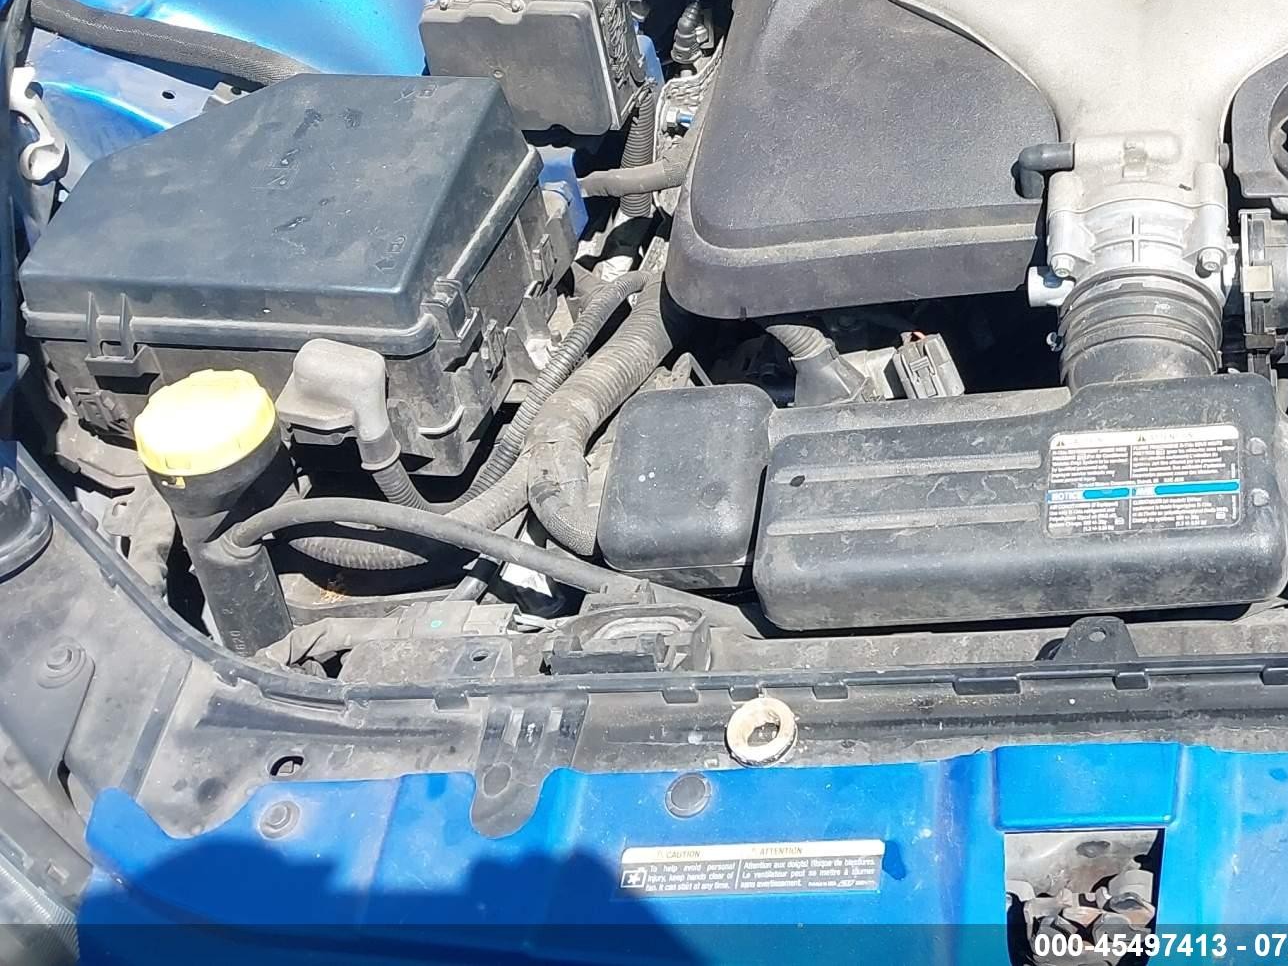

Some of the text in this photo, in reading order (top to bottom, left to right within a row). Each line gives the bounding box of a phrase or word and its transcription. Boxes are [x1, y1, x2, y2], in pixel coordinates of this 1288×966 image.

[1052, 491, 1079, 501] NOTIC
[666, 850, 700, 859] CAUTION
[759, 846, 802, 856] ATTENTION
[663, 864, 678, 873] help
[683, 862, 701, 871] avoid
[706, 862, 736, 872] personal
[744, 861, 772, 870] Attention
